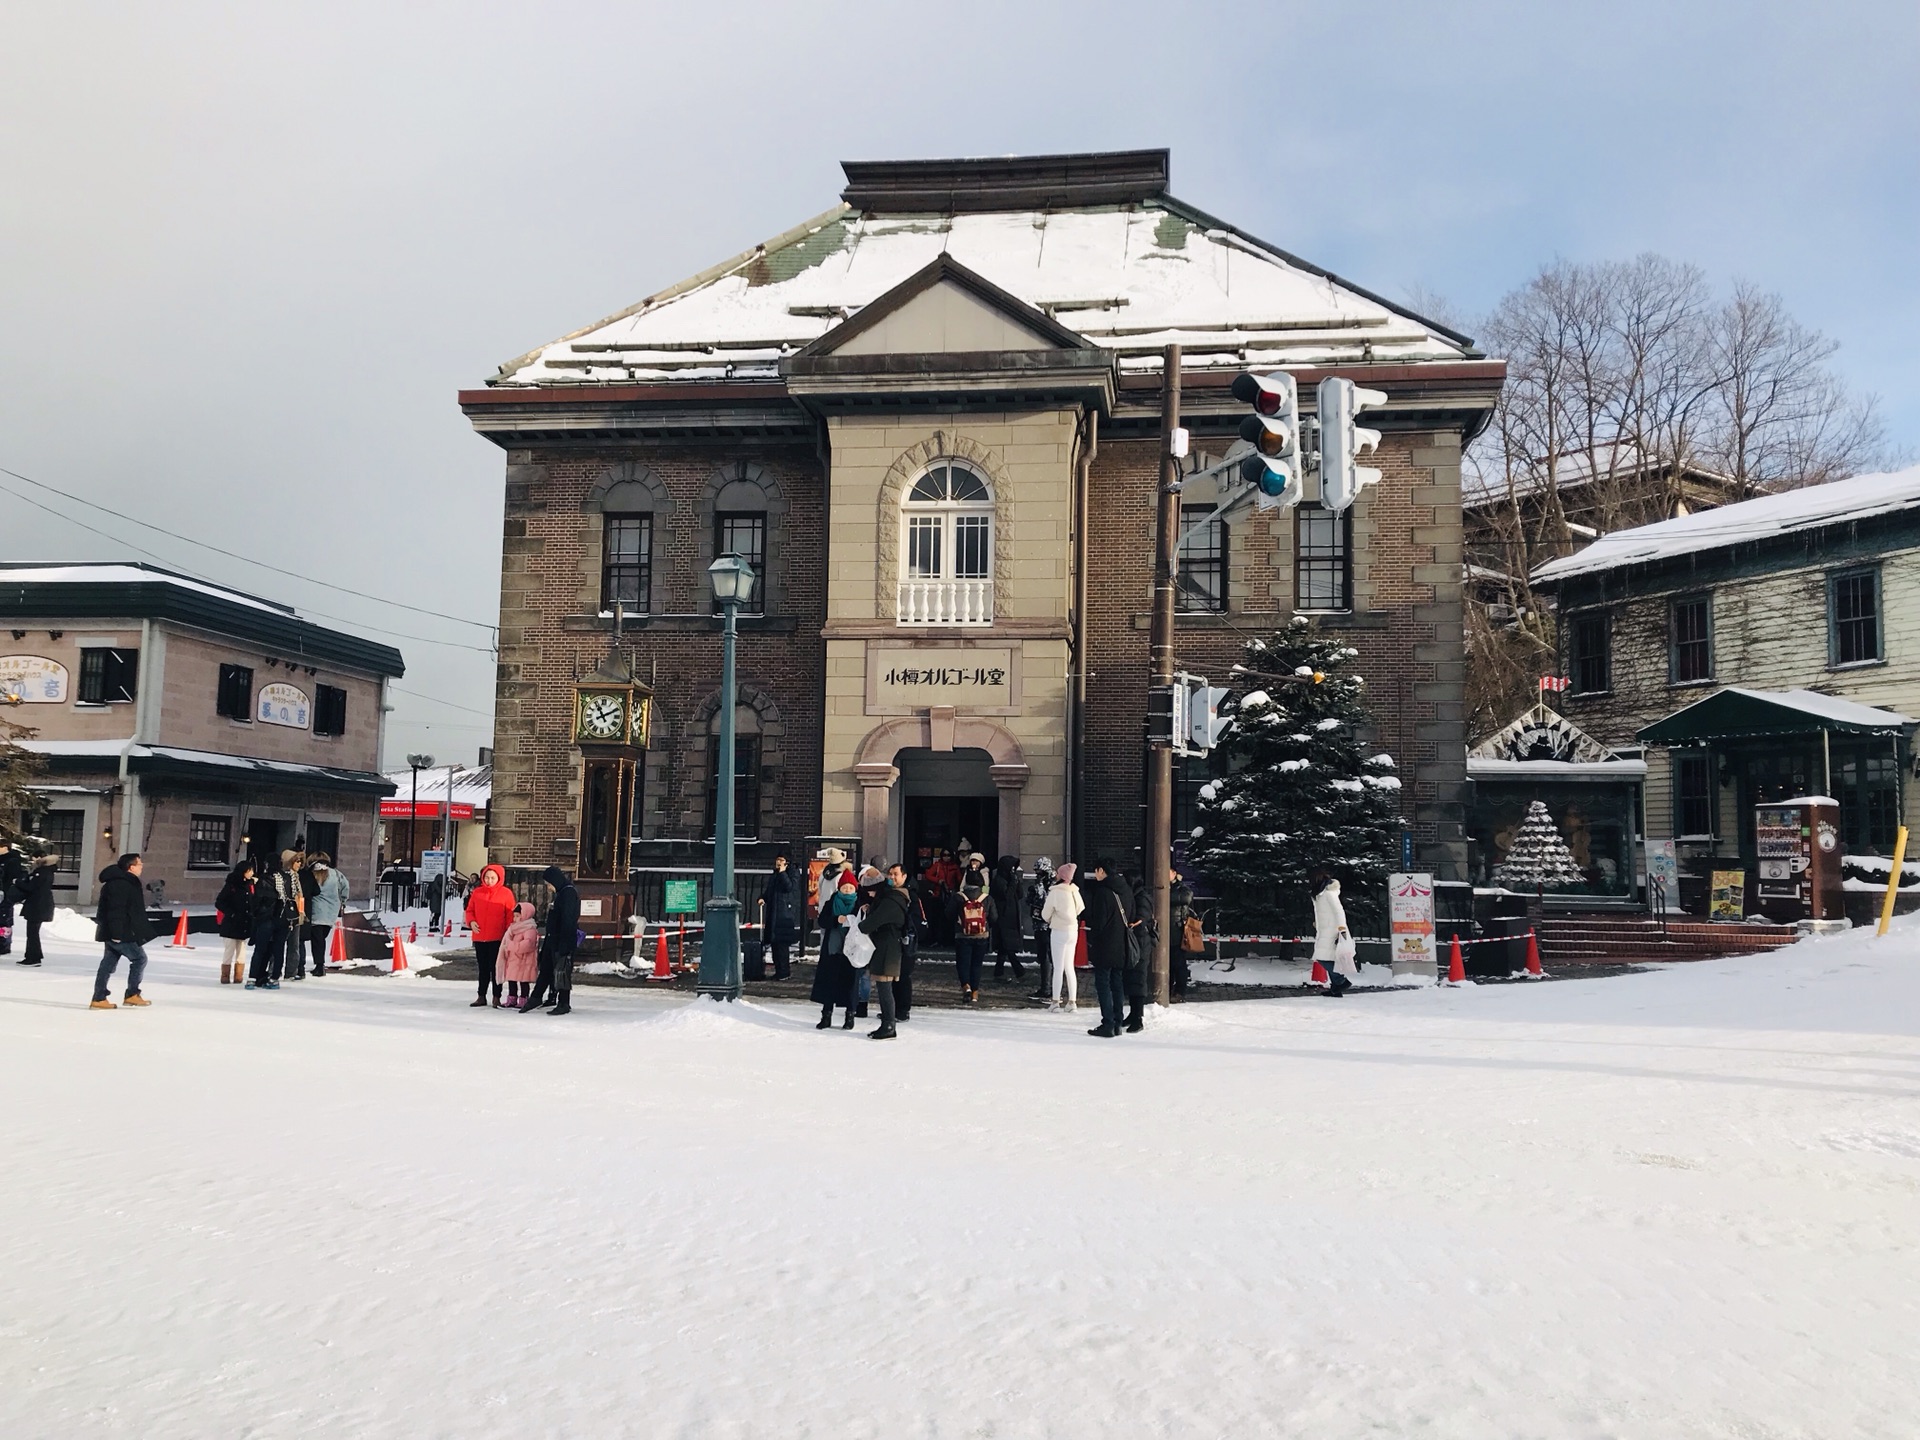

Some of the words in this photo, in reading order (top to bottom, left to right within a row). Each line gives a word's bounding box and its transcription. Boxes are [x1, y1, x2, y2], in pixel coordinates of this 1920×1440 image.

[884, 668, 1005, 685] 小樽オルゴール堂
